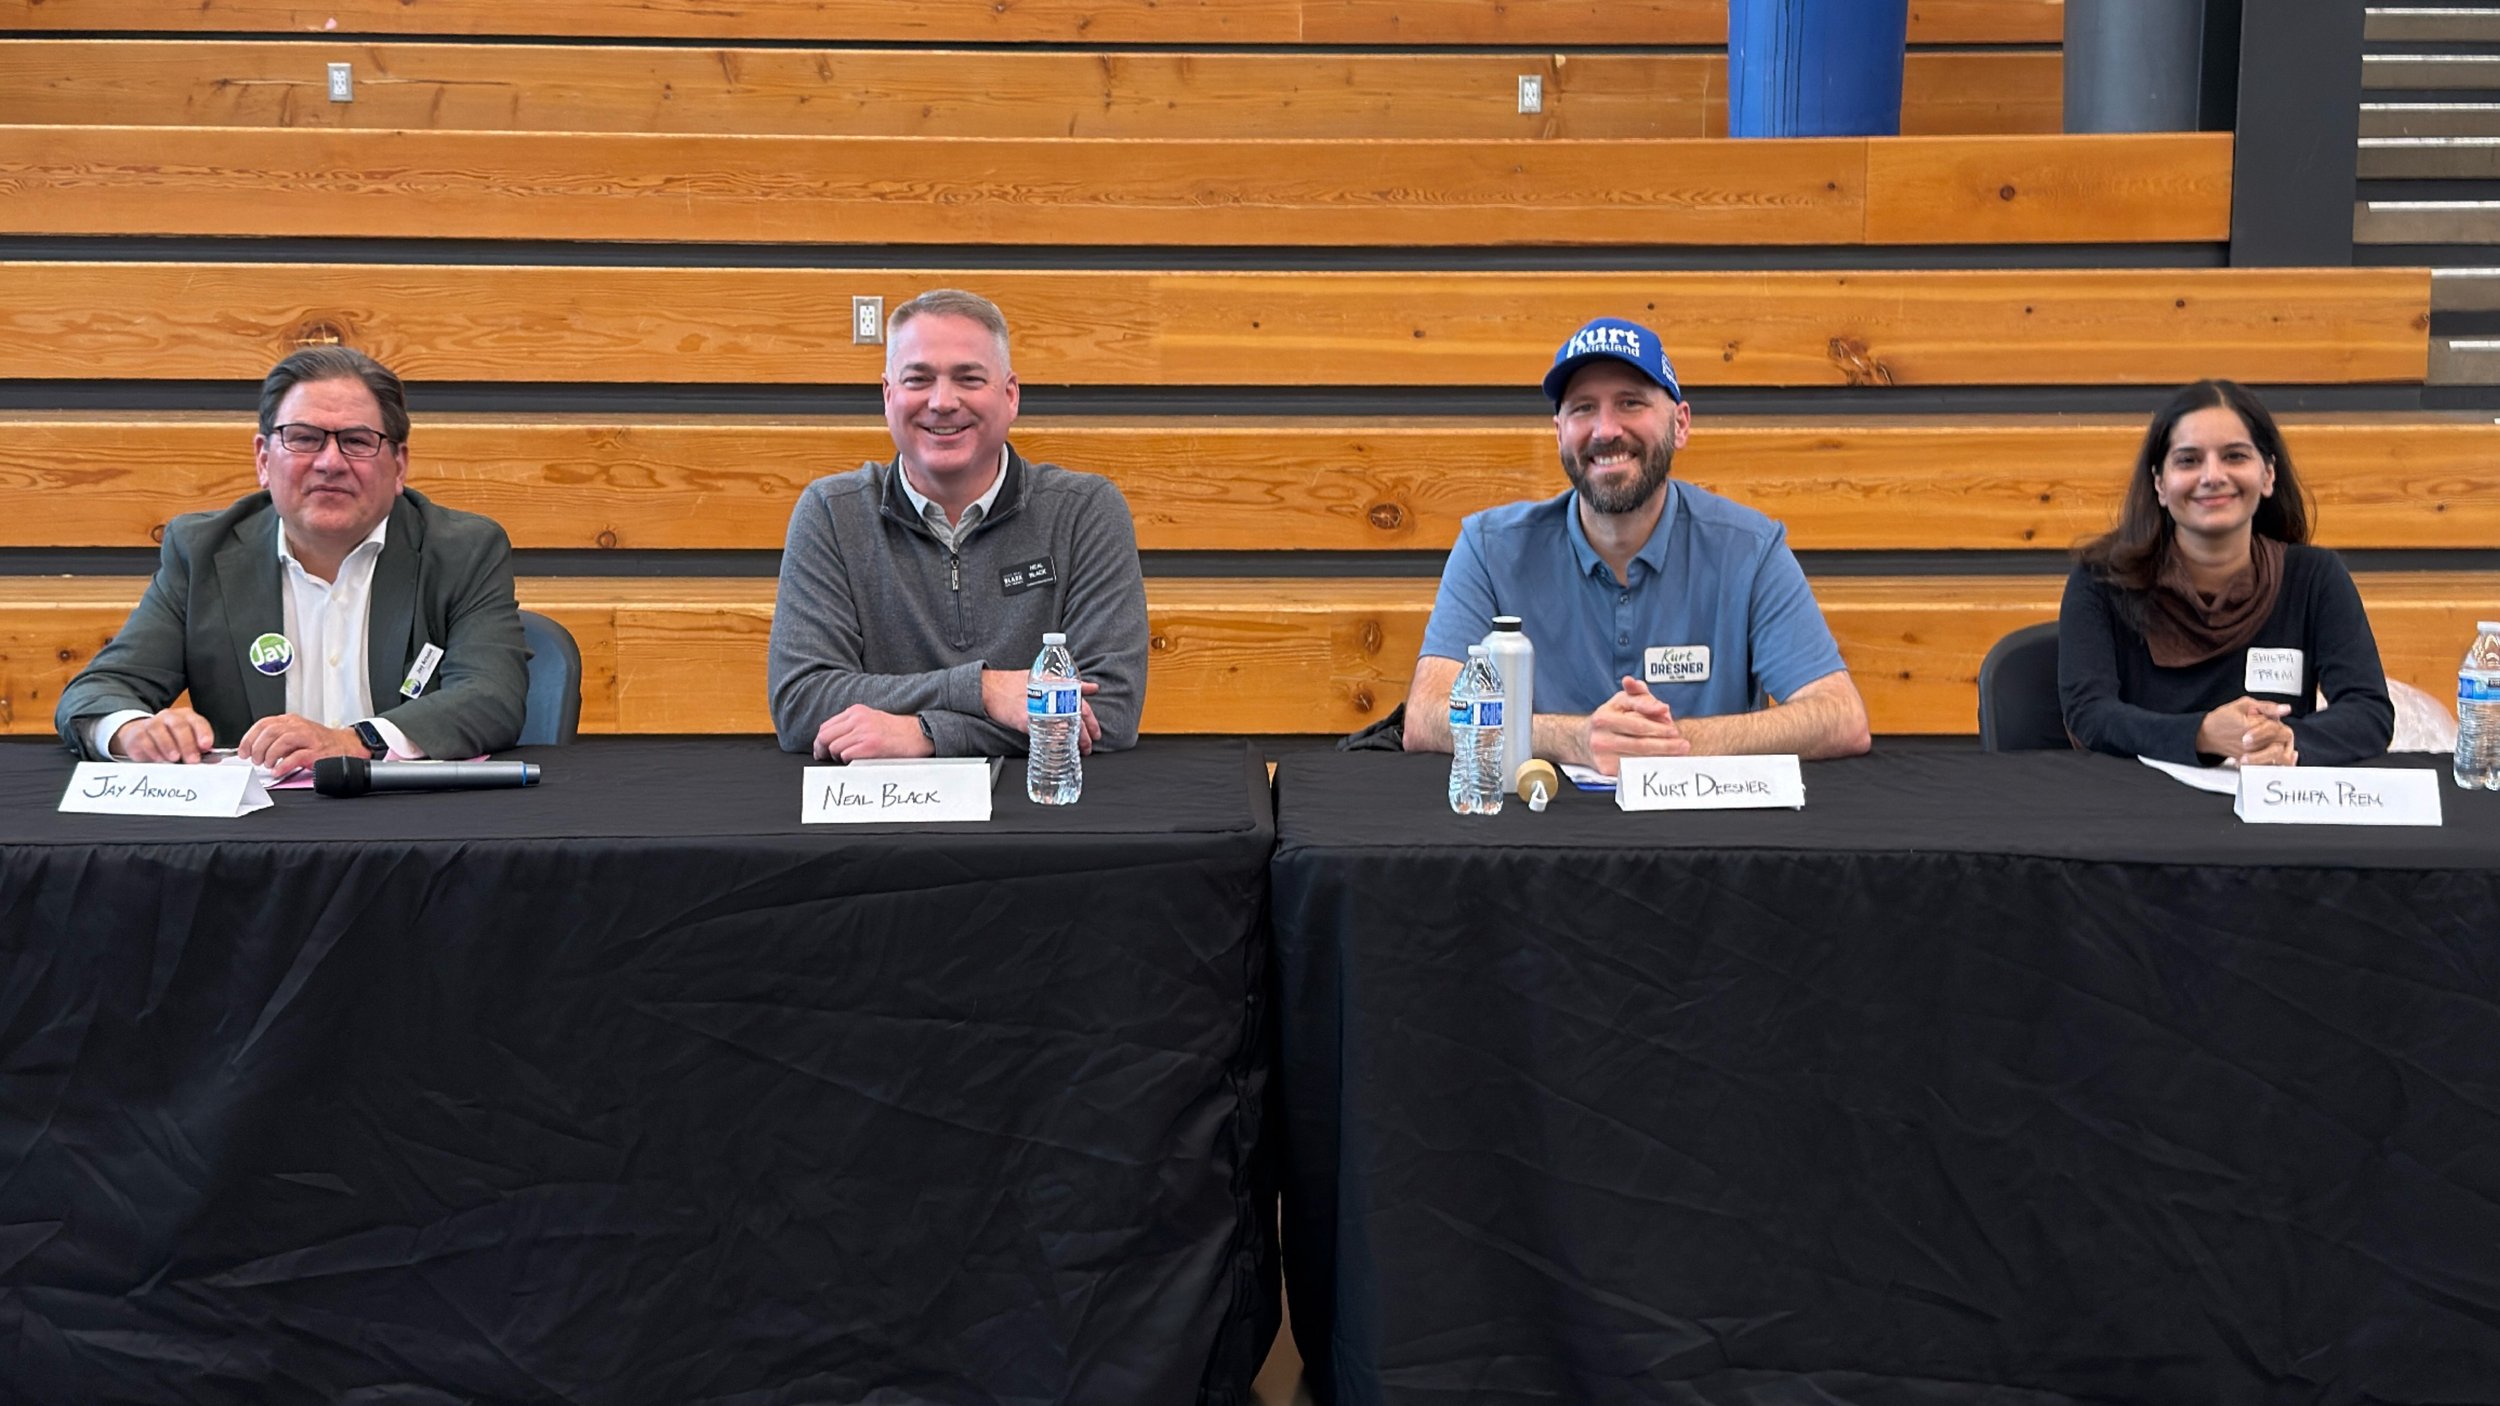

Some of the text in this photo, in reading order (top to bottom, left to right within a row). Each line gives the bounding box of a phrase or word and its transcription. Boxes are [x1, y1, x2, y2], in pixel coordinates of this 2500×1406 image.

[1566, 326, 1640, 359] Kurt
[251, 638, 290, 666] Jay
[1661, 647, 1695, 665] Kurt
[1650, 662, 1704, 676] DRESNER
[82, 774, 198, 802] JAY ARNOLD
[822, 782, 942, 810] NEAL BLACK
[1642, 771, 1771, 797] KURT DRESNER
[2262, 780, 2384, 807] SHILPA PREM
